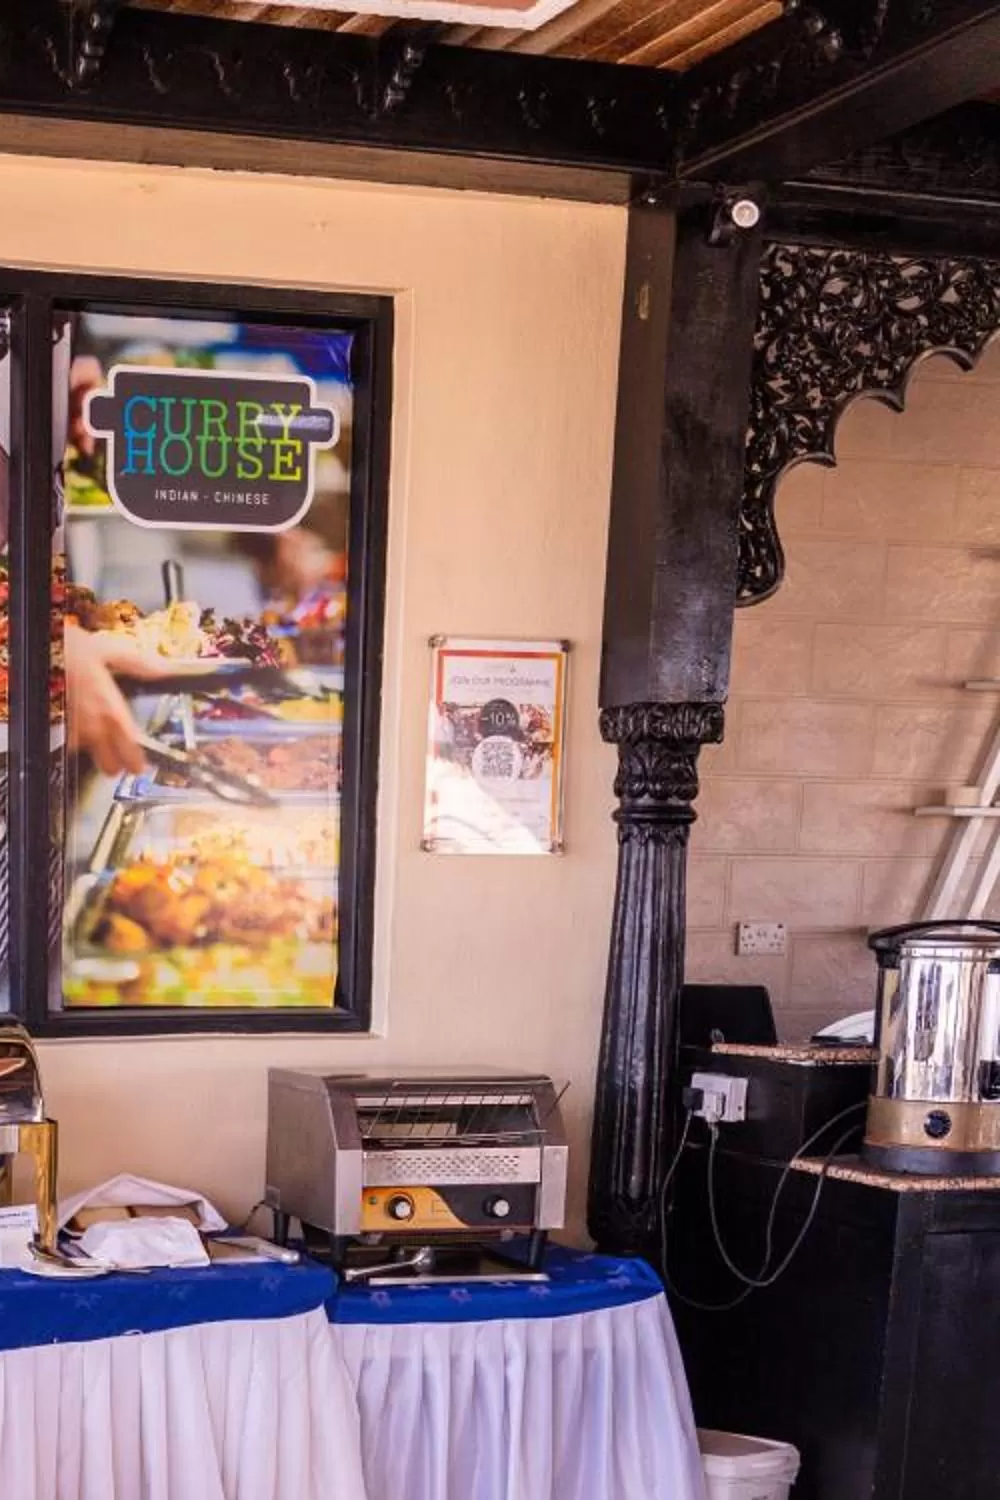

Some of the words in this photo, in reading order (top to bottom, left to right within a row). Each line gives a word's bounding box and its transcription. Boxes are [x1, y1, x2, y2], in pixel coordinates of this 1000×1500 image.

[123, 395, 302, 444] CURRY
[120, 431, 302, 481] HOUSE
[155, 489, 199, 502] INDIAN
[214, 491, 270, 505] CHINESE
